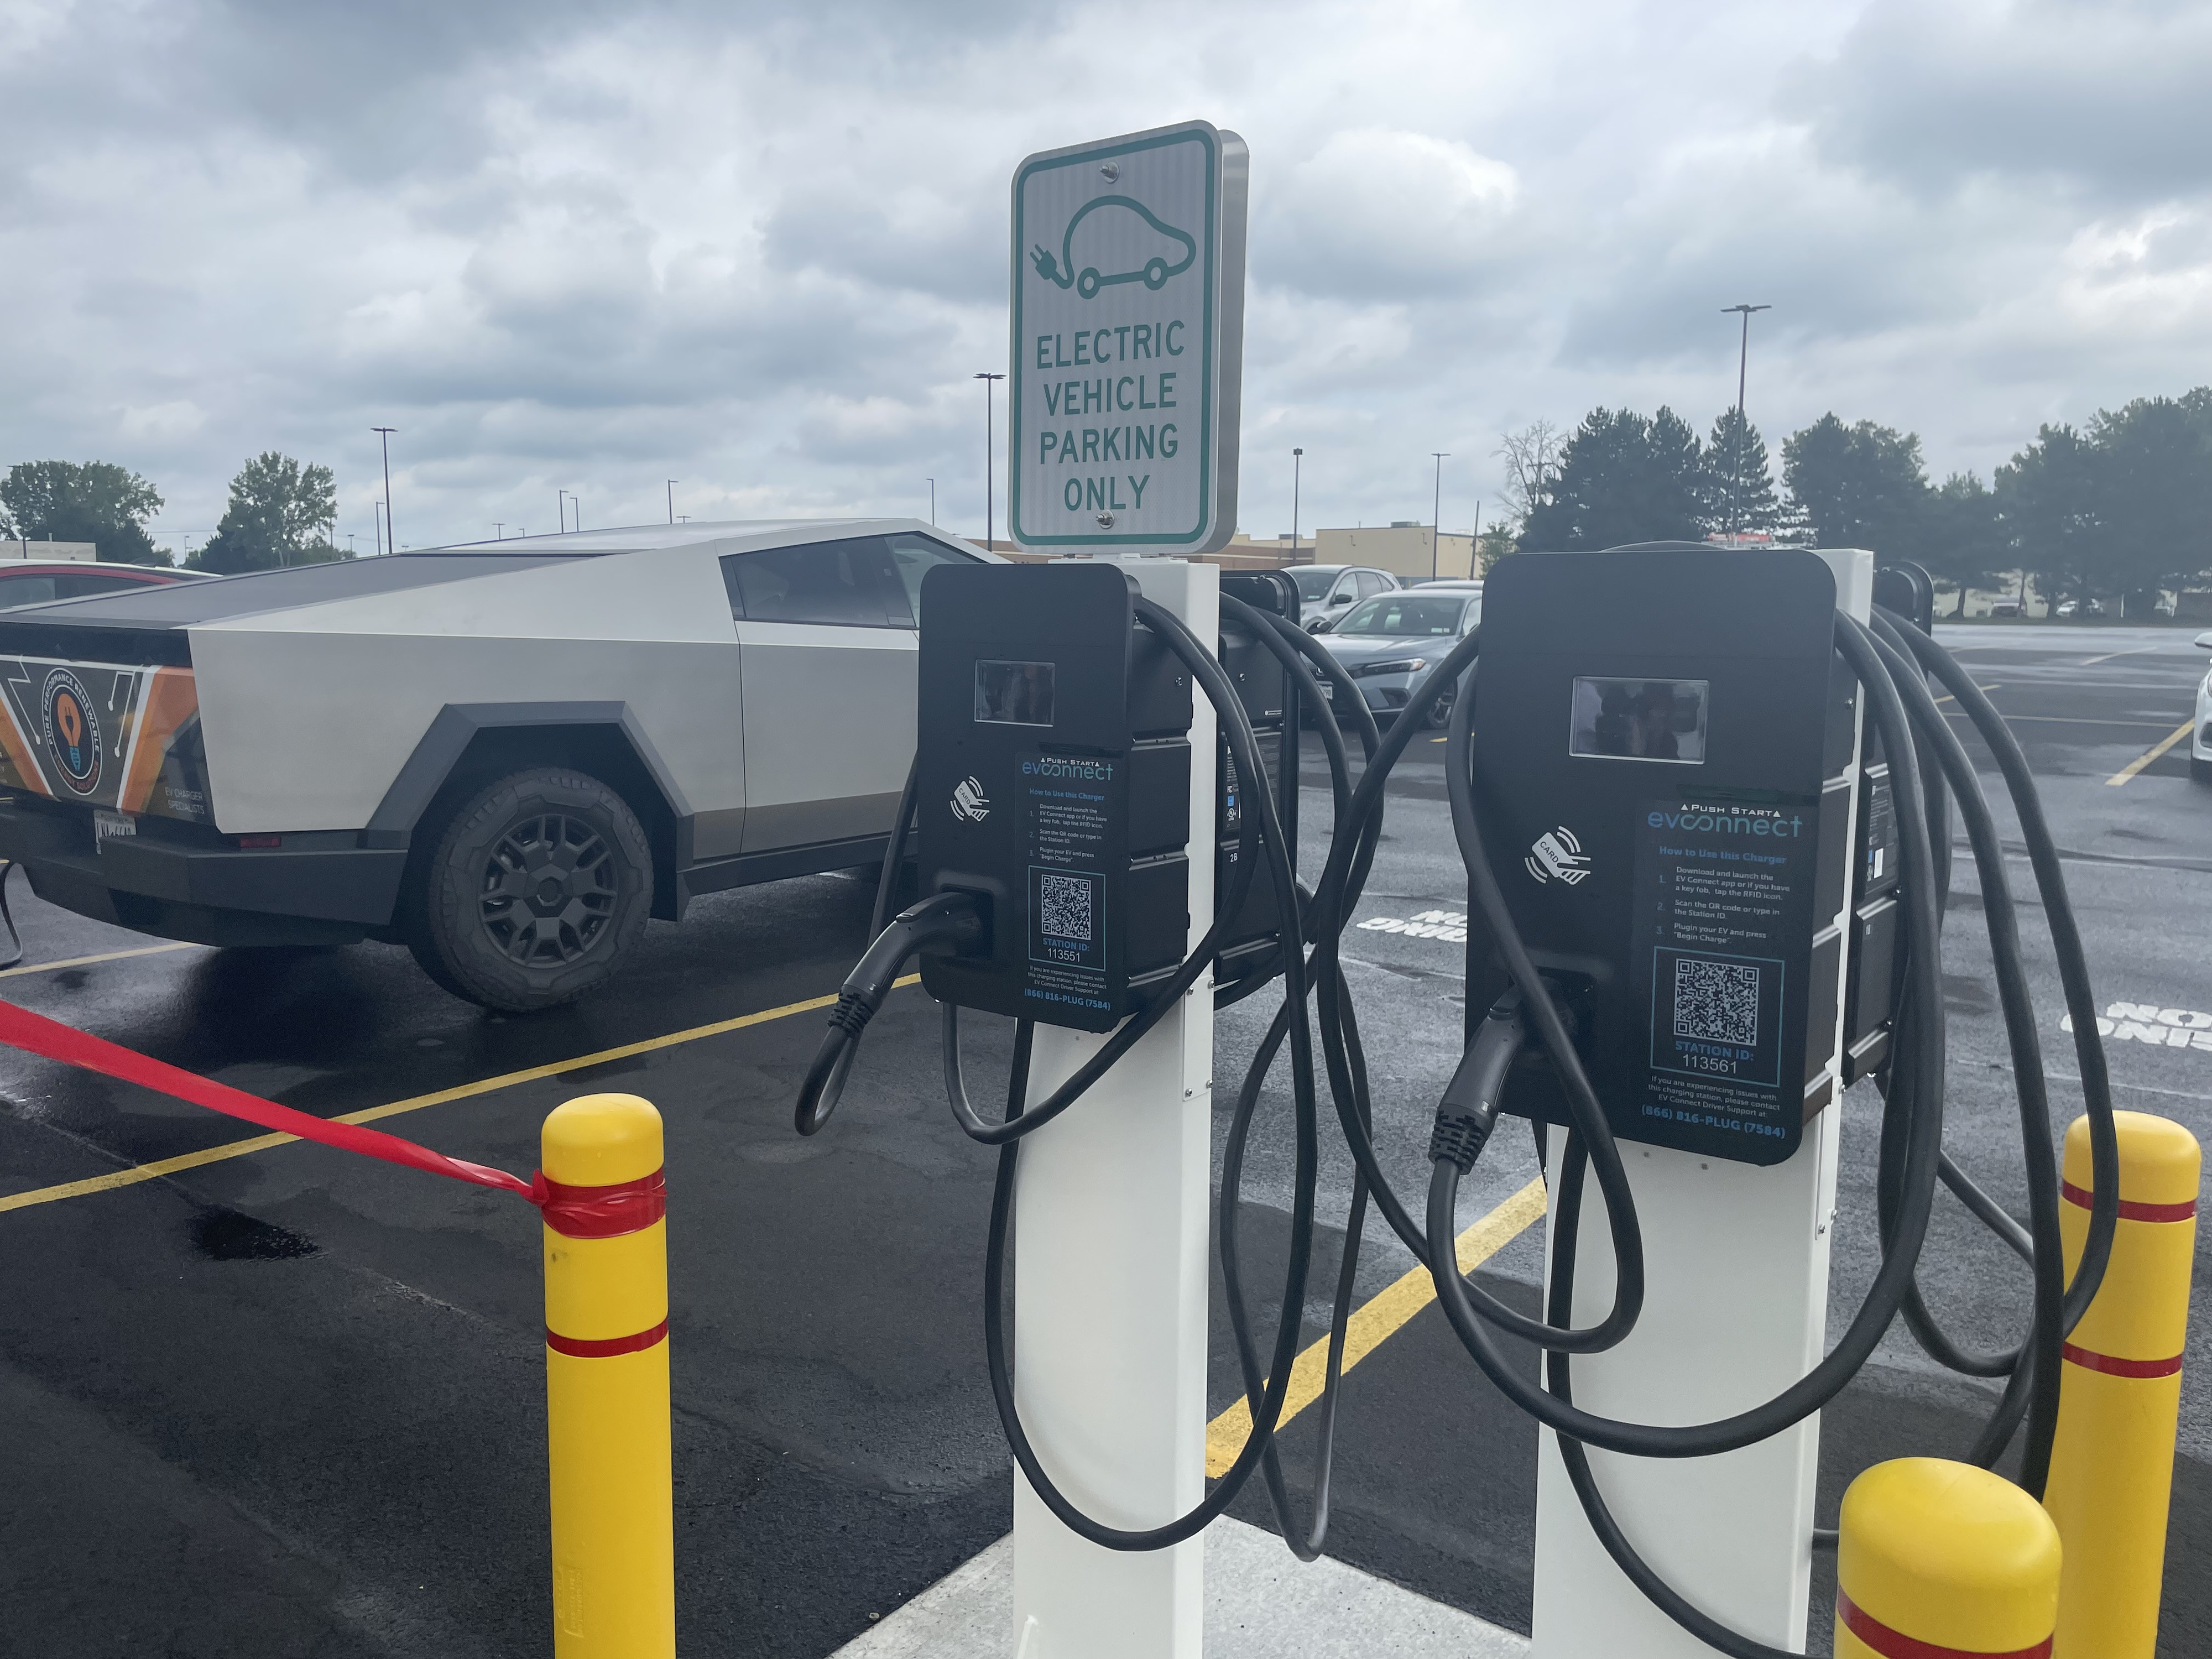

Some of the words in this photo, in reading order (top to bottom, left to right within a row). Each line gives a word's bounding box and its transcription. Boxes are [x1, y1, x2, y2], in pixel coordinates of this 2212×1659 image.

[1037, 320, 1185, 369] ELECTRIC
[1044, 372, 1177, 416] VEHICLE
[1040, 424, 1178, 465] PARKING
[1065, 474, 1150, 511] ONLY
[44, 674, 73, 712] PERFORMANCE
[75, 683, 100, 752] RENEWABLE
[1022, 761, 1113, 781] evconnect
[165, 787, 173, 796] EV
[174, 789, 203, 801] CHARGER
[958, 788, 971, 805] CARD
[1078, 792, 1104, 802] Charger
[1647, 811, 1802, 837] evconnect
[1230, 853, 1238, 863] 2B
[1540, 841, 1558, 863] CARD
[1659, 846, 1682, 855] How
[1685, 848, 1695, 857] to
[1698, 849, 1717, 858] Use
[1720, 851, 1739, 860] this
[1743, 852, 1786, 865] Charger
[1676, 867, 1714, 875] Download
[1732, 871, 1759, 879] launch
[1687, 877, 1719, 885] Connect
[1681, 885, 1694, 893] key
[1688, 910, 1714, 918] Station
[1674, 922, 1697, 932] Plugin
[1746, 931, 1766, 940] press
[1042, 937, 1076, 950] STATION
[1078, 942, 1089, 952] ID:
[1047, 947, 1080, 962] 113551
[1024, 988, 1043, 999] (866)
[1045, 992, 1083, 1005] 816-PLUG
[1086, 998, 1110, 1011] (7584)
[1675, 1040, 1731, 1058] STATION
[1735, 1048, 1753, 1061] ID:
[1682, 1053, 1736, 1074] 113561
[1662, 1086, 1694, 1098] charging
[1695, 1091, 1723, 1102] station,
[1725, 1095, 1749, 1107] please
[1750, 1099, 1780, 1110] contact
[1686, 1081, 1733, 1095] experiencing
[1735, 1088, 1758, 1098] issues
[1760, 1092, 1776, 1100] with
[1641, 1104, 1673, 1120] (866)
[1676, 1111, 1740, 1130] 816-PLUG
[1744, 1123, 1786, 1139] (7584)
